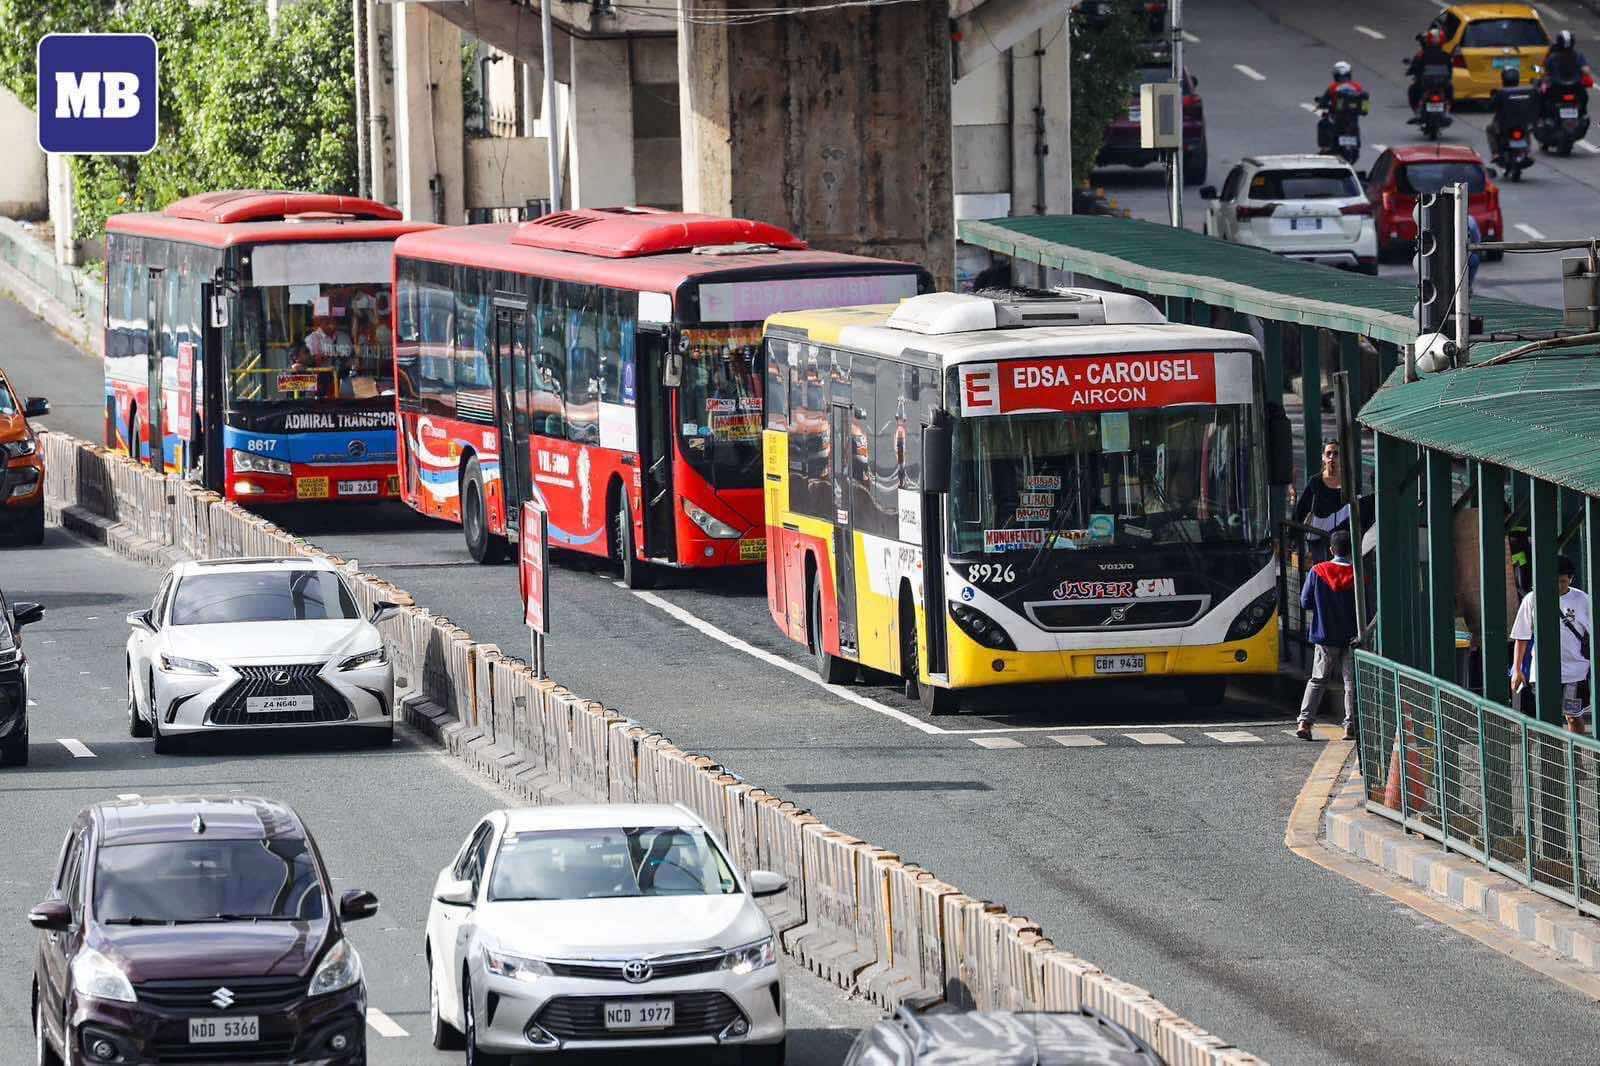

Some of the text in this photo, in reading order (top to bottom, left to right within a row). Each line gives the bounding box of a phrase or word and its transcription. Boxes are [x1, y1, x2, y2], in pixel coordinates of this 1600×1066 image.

[1013, 365, 1070, 389] EDSA
[1087, 359, 1199, 384] CAROUSEL
[965, 372, 993, 408] E
[1071, 386, 1147, 405] AIRCON
[285, 411, 396, 429] ADMIRAL TRANSPOR
[248, 439, 277, 451] 8617
[985, 530, 1042, 545] MONUMENTO
[968, 563, 1016, 583] 8926
[1053, 580, 1136, 599] JASPER
[607, 1007, 671, 1023] NCD 1977
[191, 1021, 257, 1038] NDD 5366
